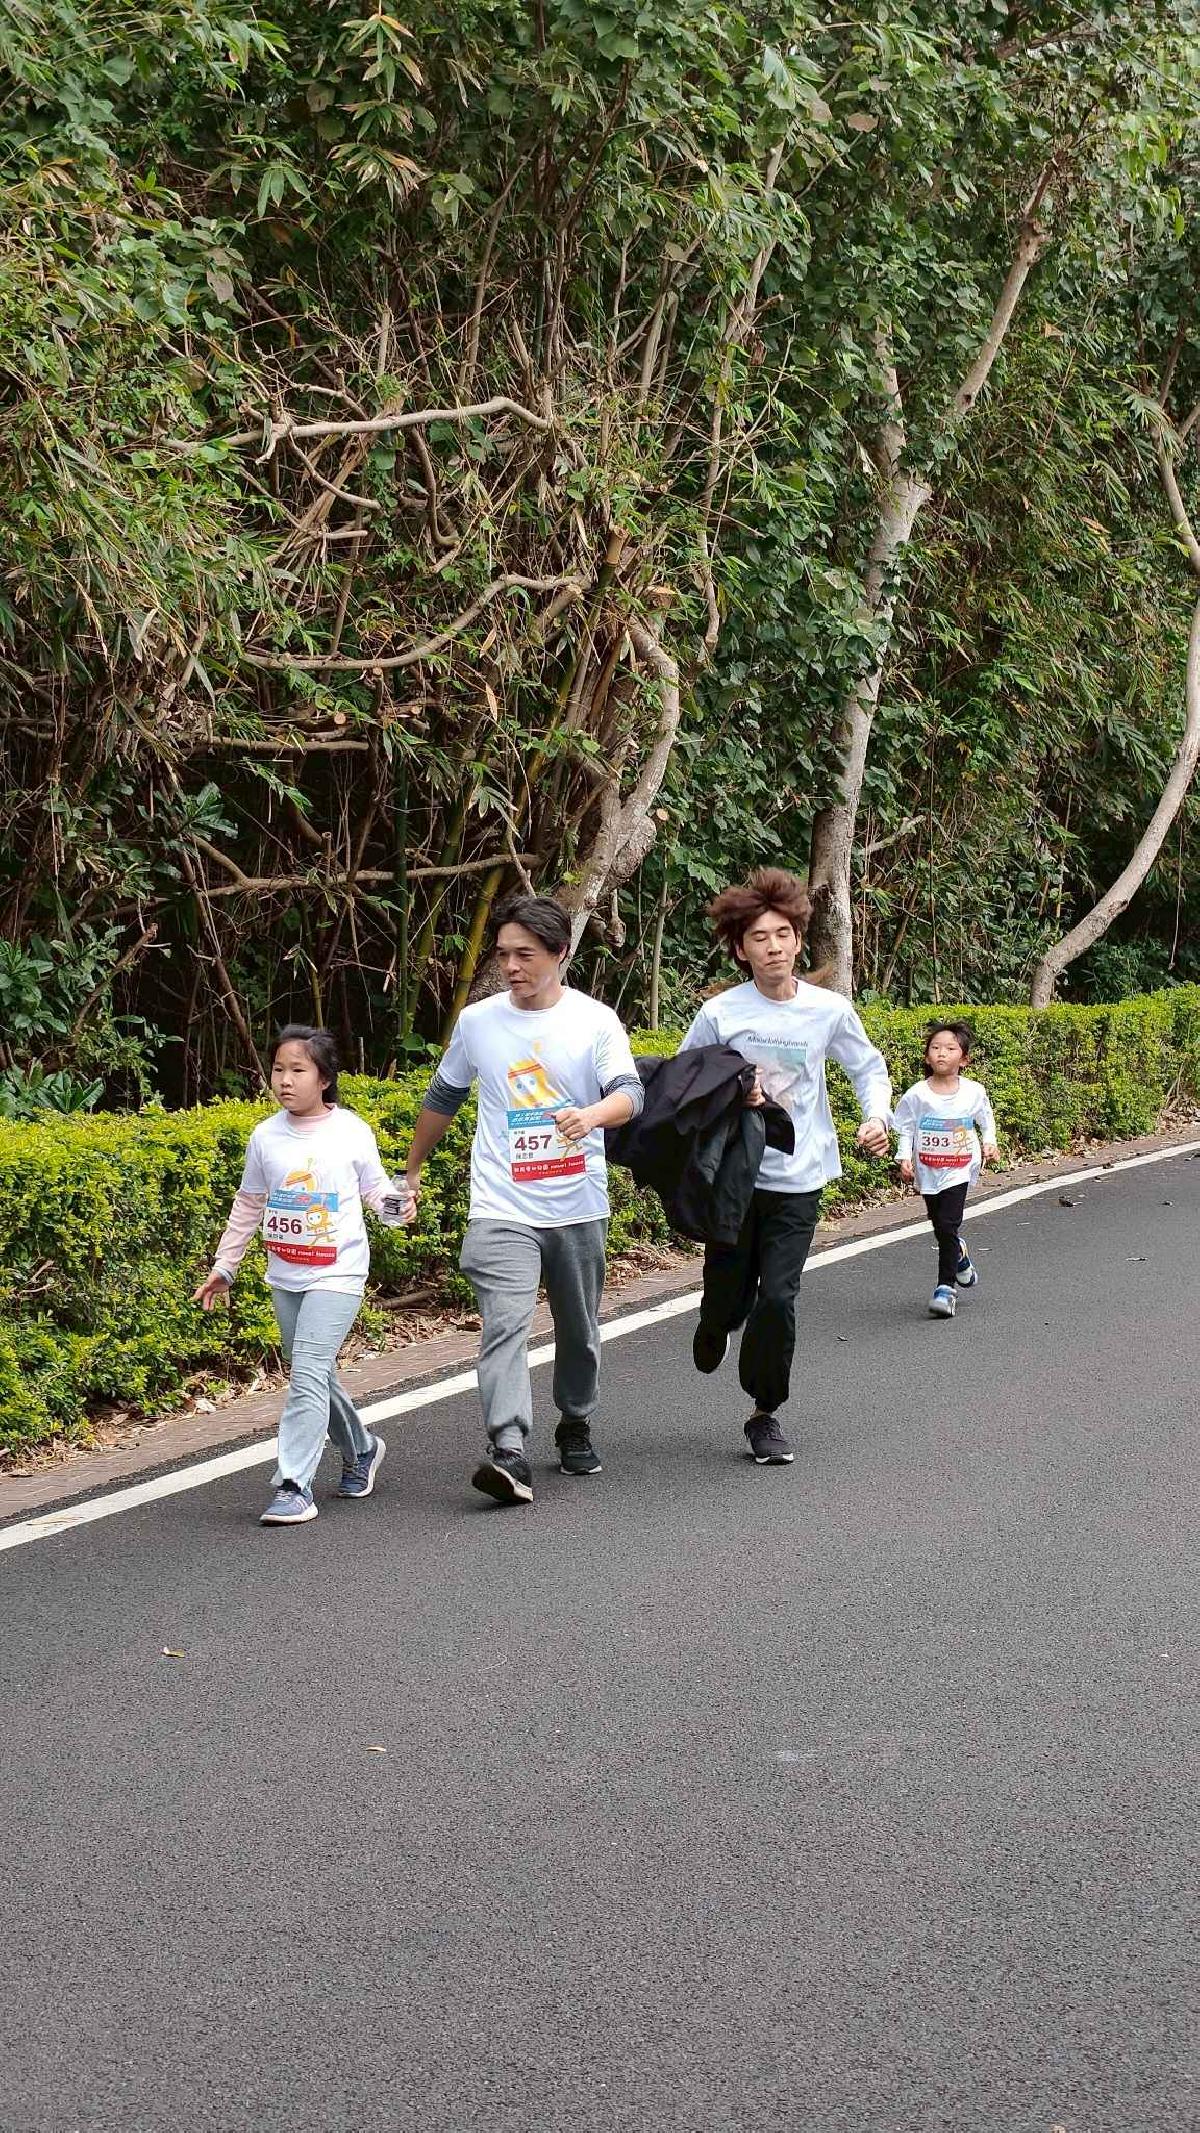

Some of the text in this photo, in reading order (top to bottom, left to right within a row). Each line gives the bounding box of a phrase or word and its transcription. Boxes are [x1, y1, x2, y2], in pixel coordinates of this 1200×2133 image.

[514, 1134, 552, 1151] 457
[922, 1136, 949, 1147] 393
[267, 1216, 303, 1235] 456
